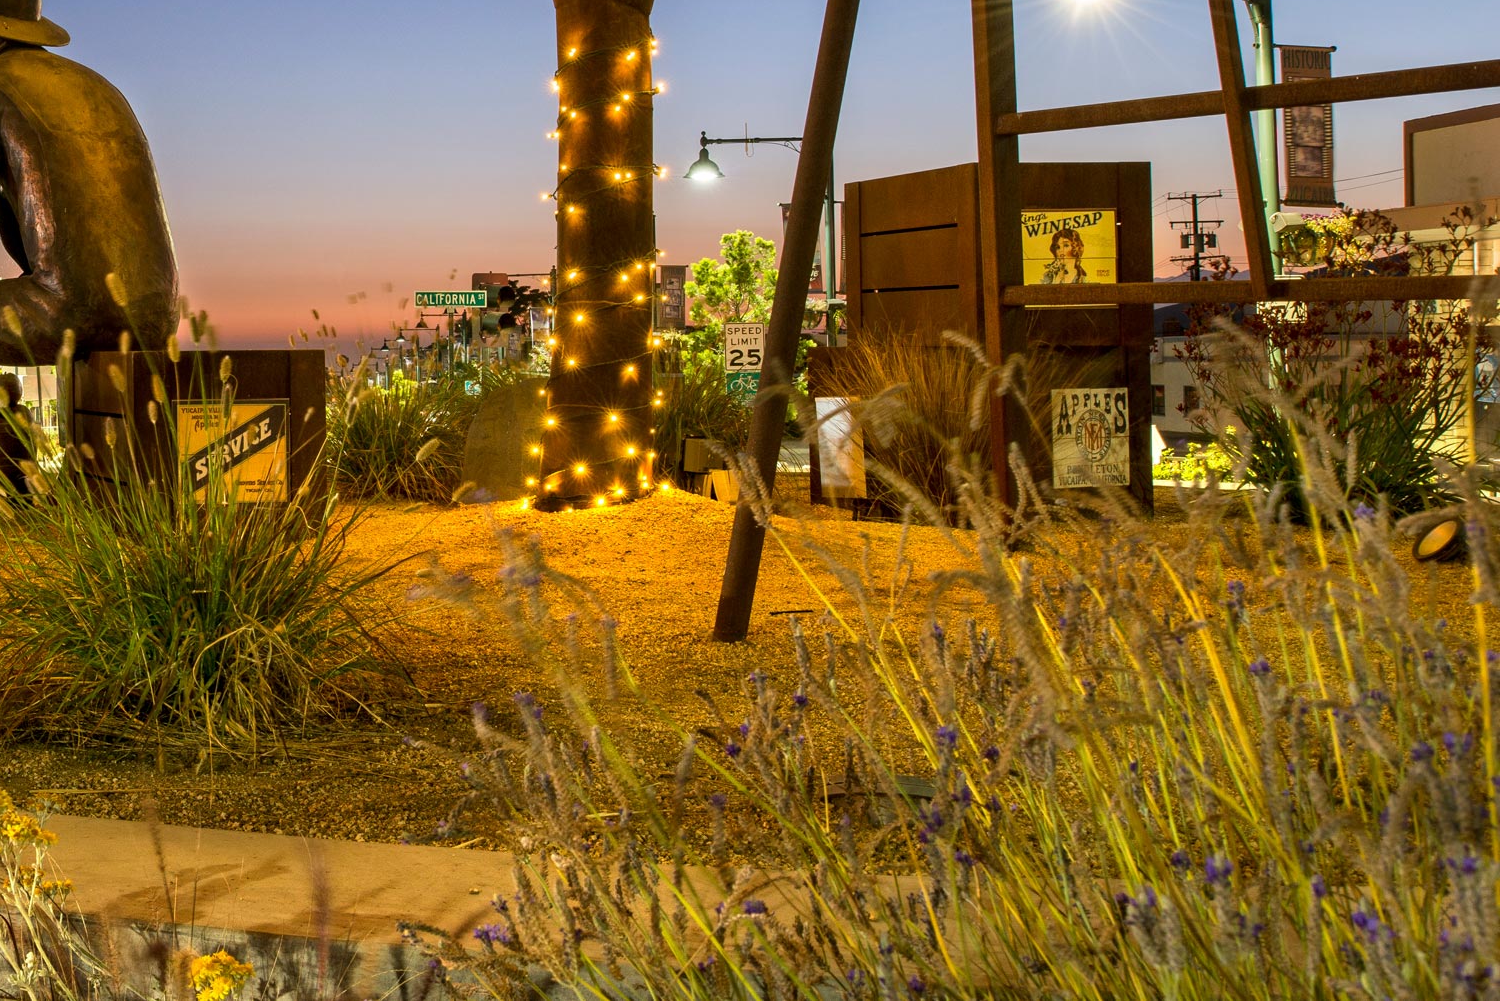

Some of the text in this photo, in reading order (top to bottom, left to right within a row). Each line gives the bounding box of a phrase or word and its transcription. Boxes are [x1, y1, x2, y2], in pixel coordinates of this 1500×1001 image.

[1284, 50, 1330, 70] HISTORIC
[1025, 211, 1102, 239] WINESAP
[416, 293, 477, 306] CALIFORNIA
[727, 327, 762, 335] SPEED
[730, 337, 759, 346] LIMIT
[729, 348, 762, 367] 25
[1057, 392, 1127, 436] APPLES
[194, 420, 220, 433] Aples
